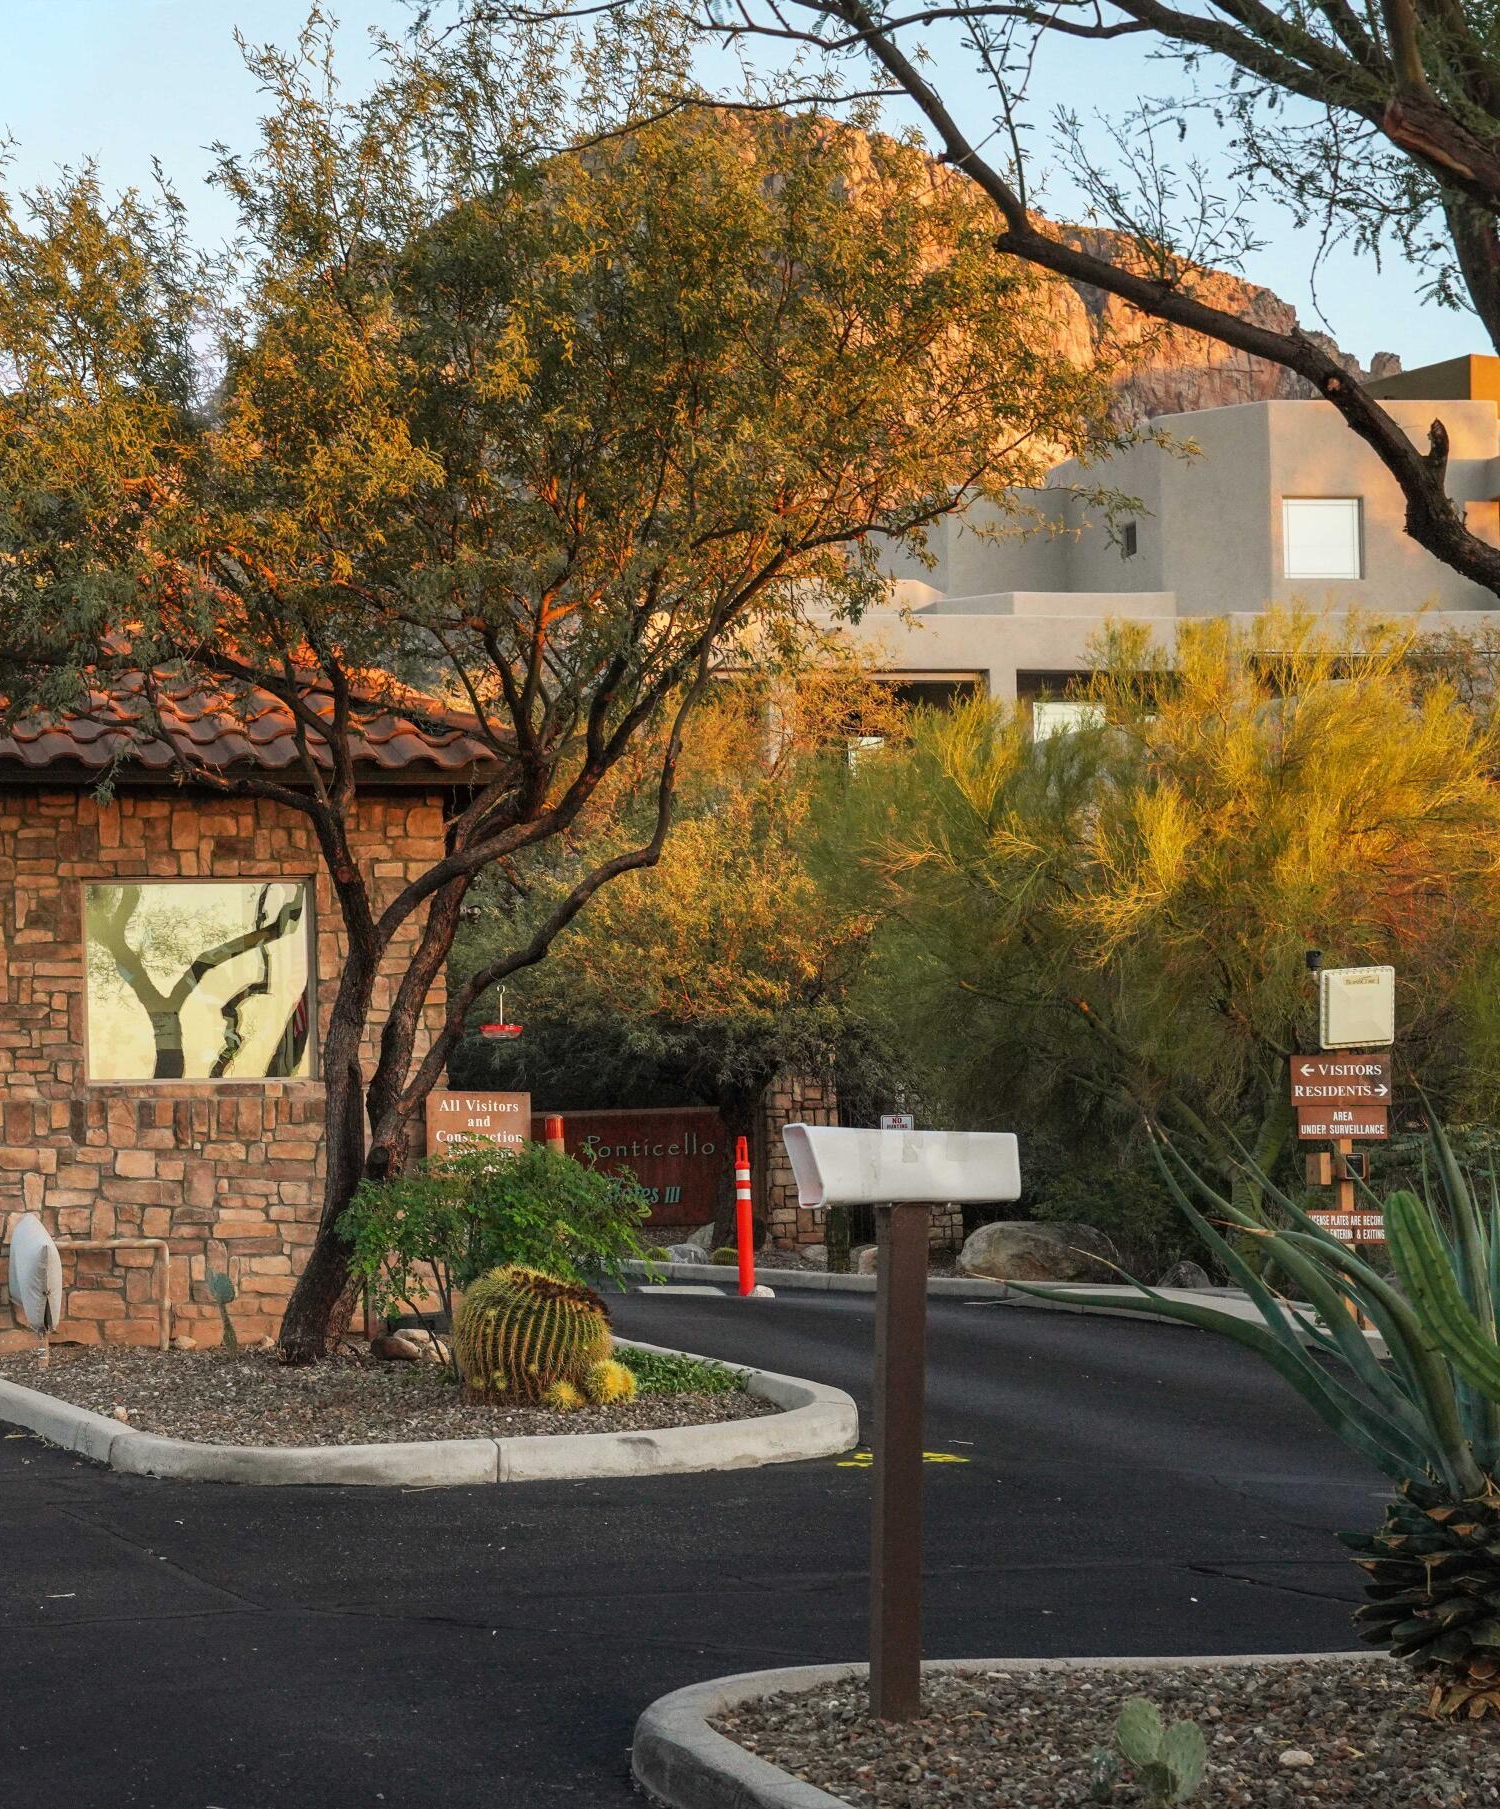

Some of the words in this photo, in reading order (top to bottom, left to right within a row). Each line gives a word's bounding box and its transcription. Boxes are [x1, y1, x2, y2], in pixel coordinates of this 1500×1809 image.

[1318, 1064, 1382, 1076] VISITORS
[1294, 1085, 1372, 1097] RESIDENTS
[439, 1099, 460, 1112] All
[465, 1099, 519, 1112] Visitors
[467, 1115, 491, 1127] and
[1333, 1111, 1353, 1121] AREA
[1301, 1124, 1327, 1134] UNDER
[1329, 1124, 1385, 1134] SURVEILLANCE
[435, 1130, 523, 1143] Constrction
[586, 1131, 715, 1158] Ponticello
[664, 1186, 681, 1203] III
[1331, 1215, 1350, 1226] PLATES
[1350, 1215, 1361, 1226] ARE
[1330, 1229, 1354, 1240] ENTERIN
[1356, 1229, 1361, 1240] &
[1363, 1229, 1385, 1240] EXITING
